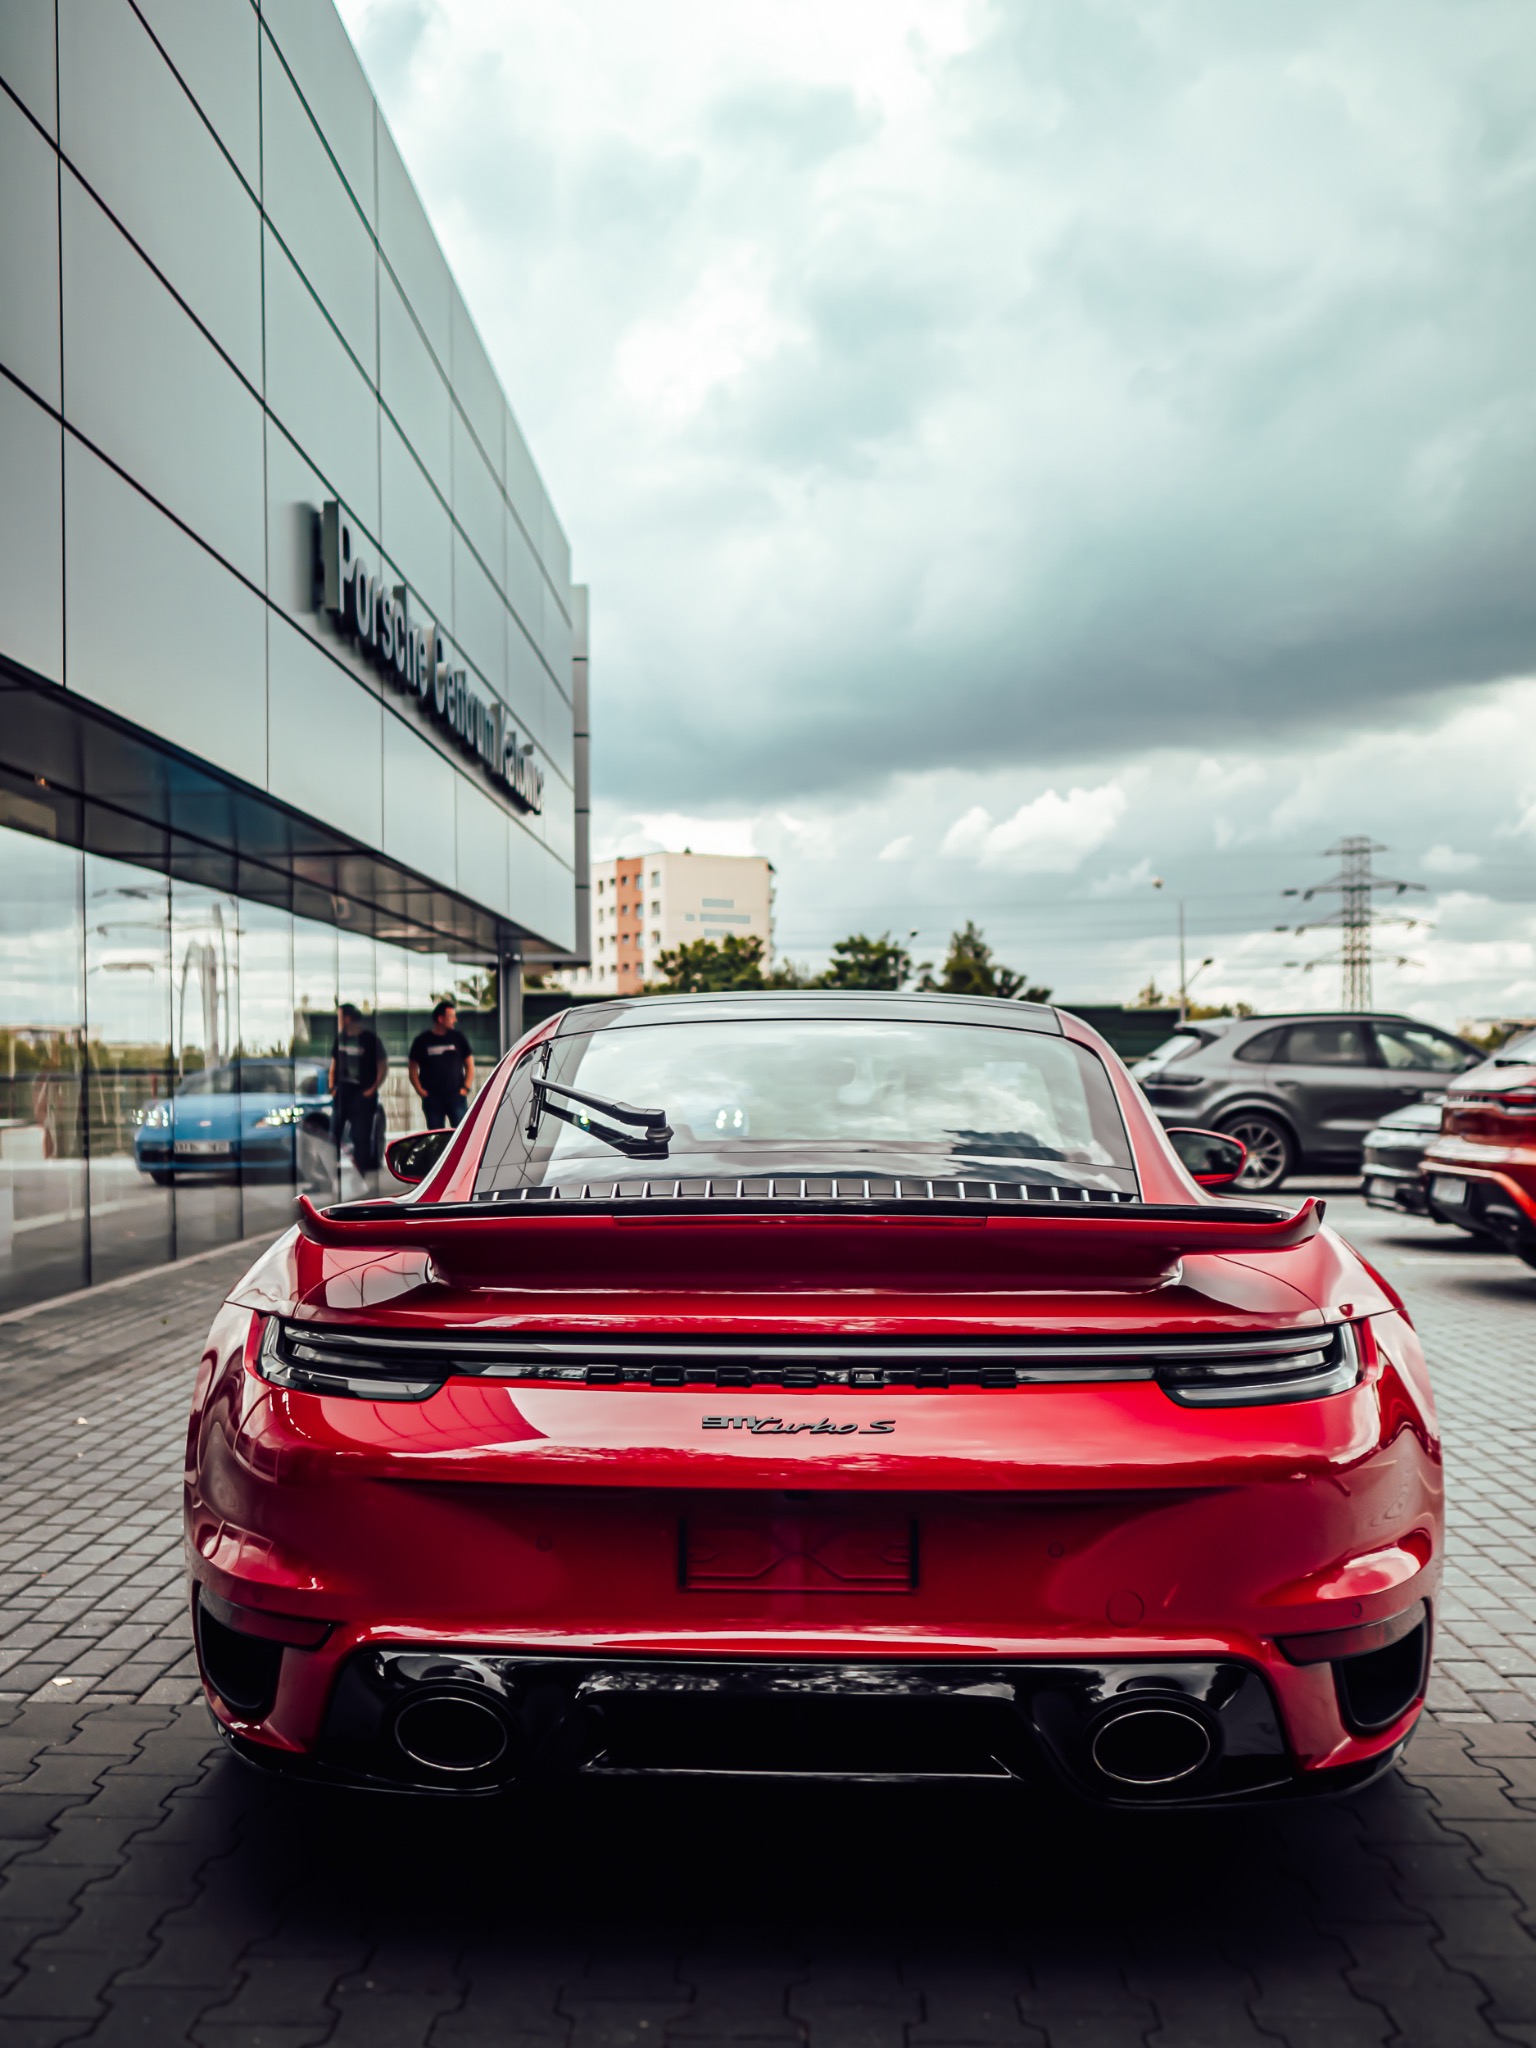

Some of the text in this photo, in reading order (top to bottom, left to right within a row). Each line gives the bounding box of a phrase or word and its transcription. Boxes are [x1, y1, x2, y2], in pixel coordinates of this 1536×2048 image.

[325, 500, 428, 698] Porsche
[586, 1364, 1017, 1388] PORSCHE
[702, 1415, 757, 1429] 911
[858, 1419, 896, 1435] S
